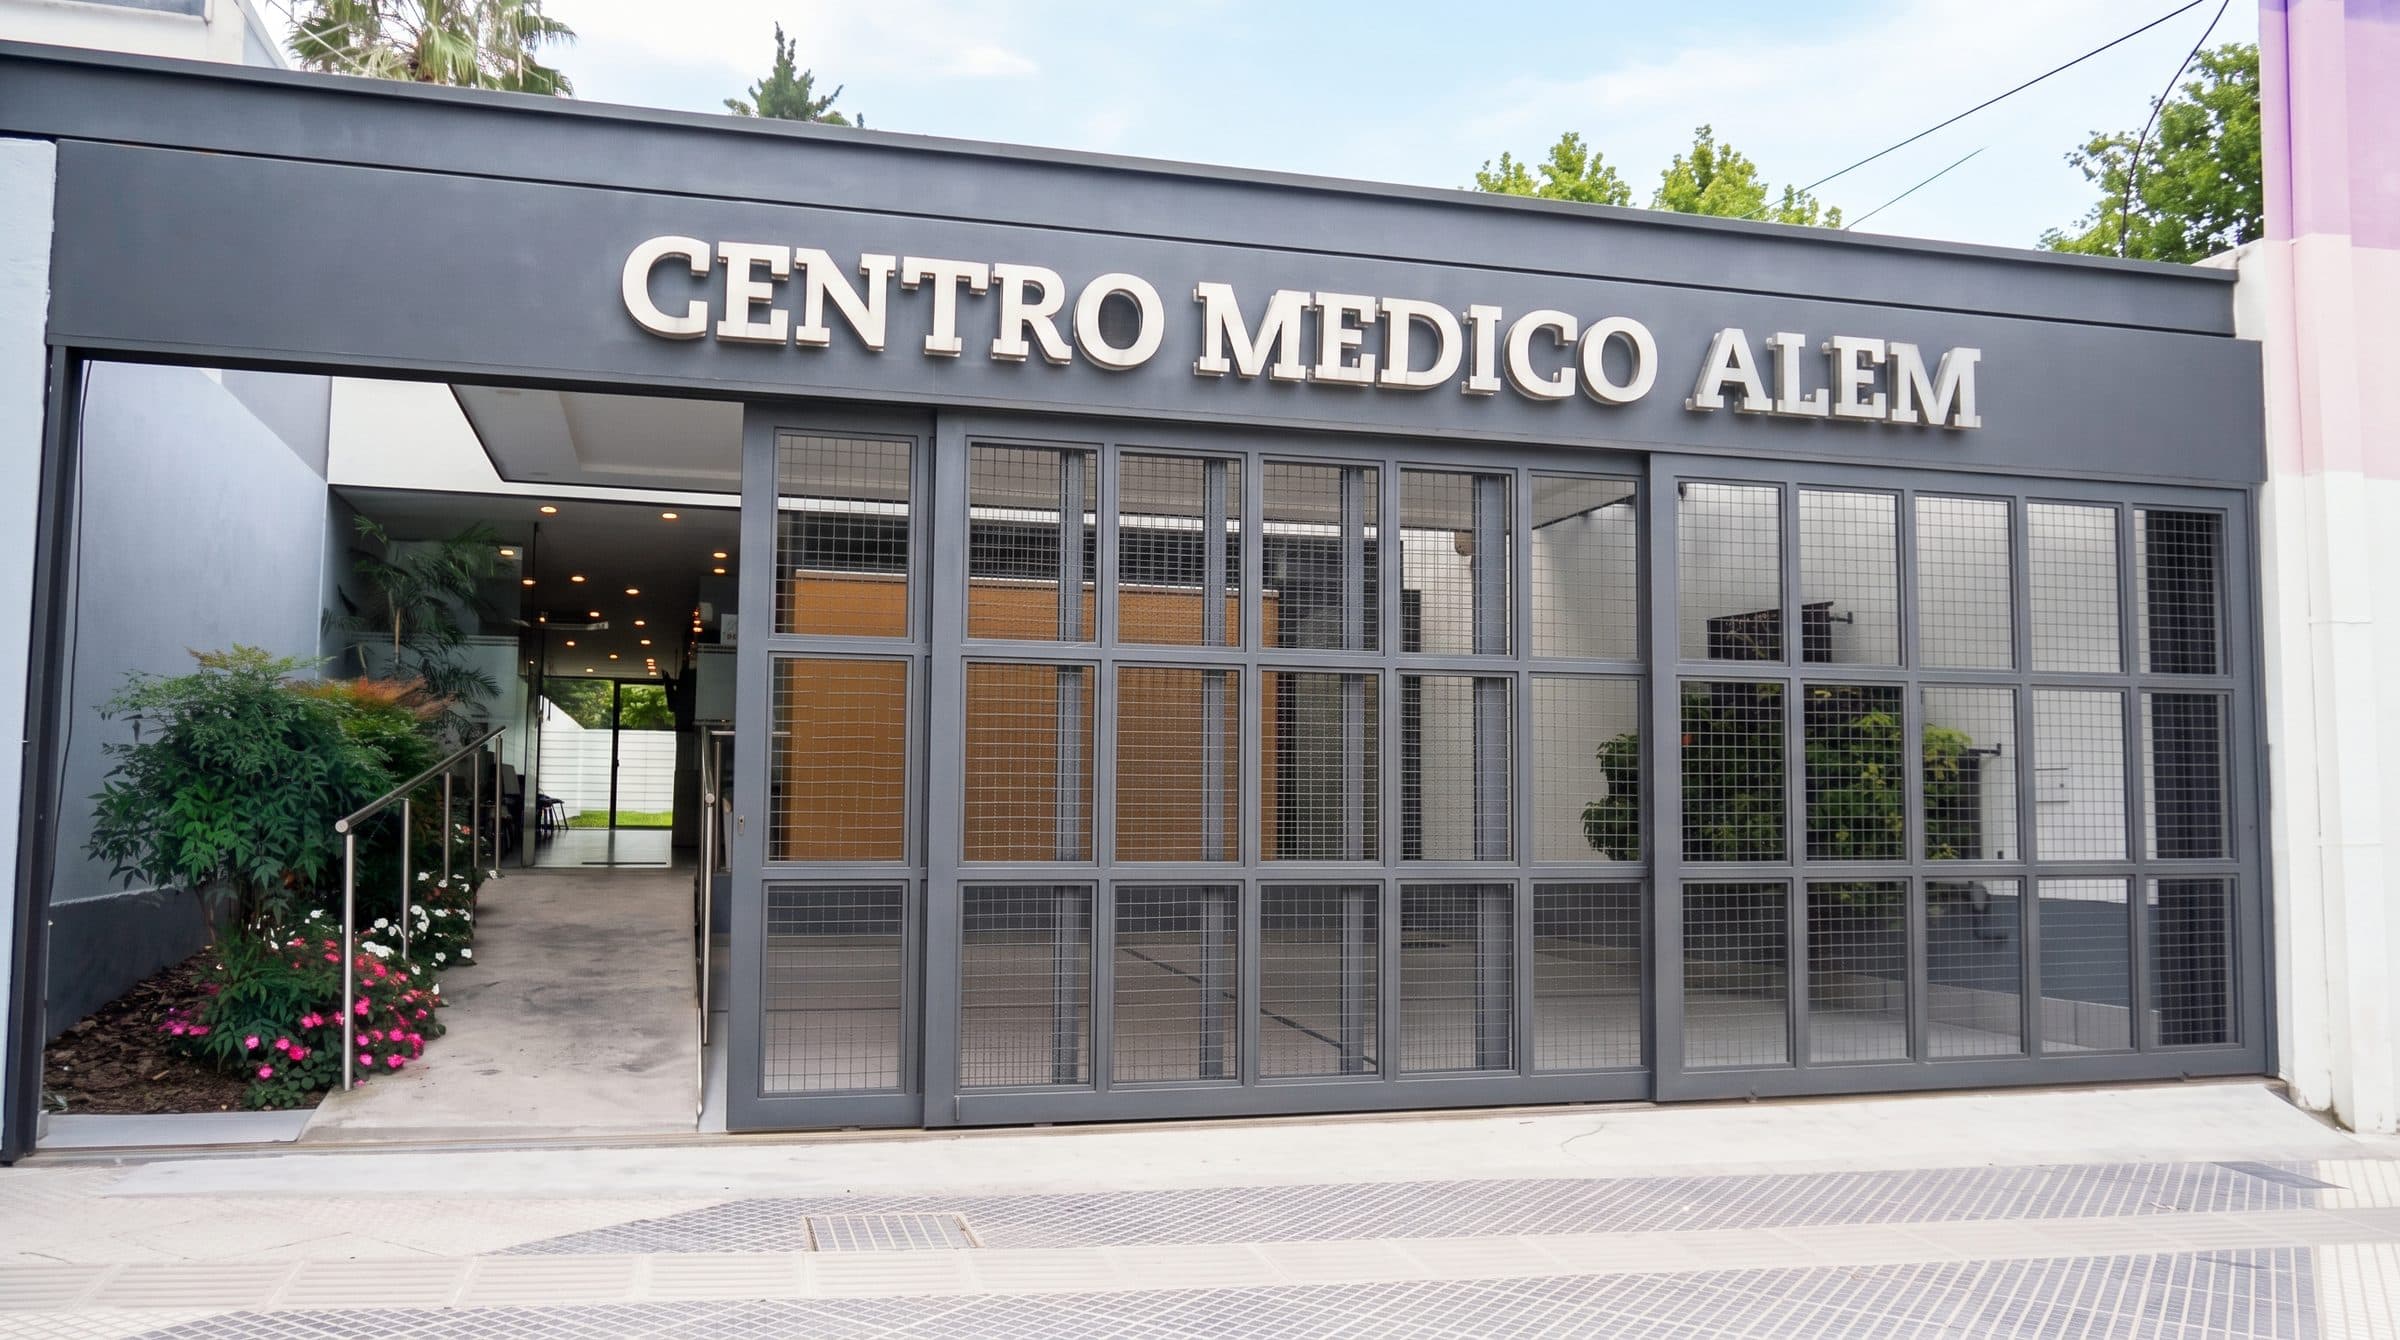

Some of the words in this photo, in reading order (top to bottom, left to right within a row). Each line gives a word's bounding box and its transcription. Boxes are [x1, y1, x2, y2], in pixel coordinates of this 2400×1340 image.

[622, 236, 1165, 370] CENTRO
[1194, 281, 1658, 405] MEDICO
[1686, 327, 1982, 429] ALEM
